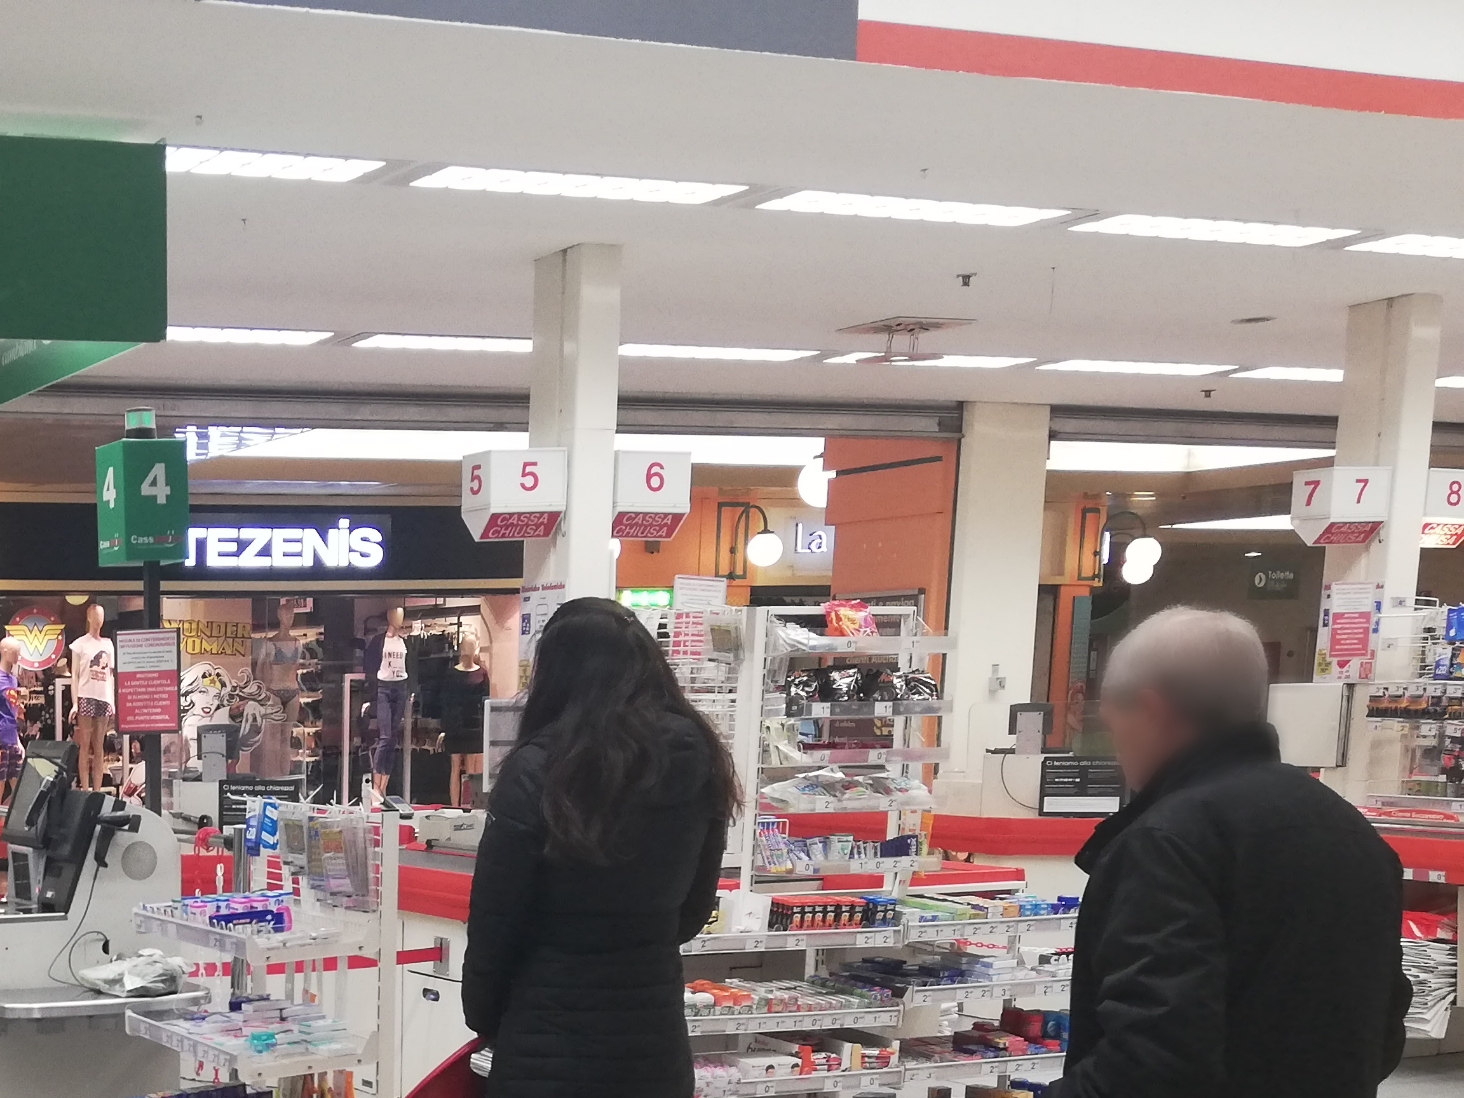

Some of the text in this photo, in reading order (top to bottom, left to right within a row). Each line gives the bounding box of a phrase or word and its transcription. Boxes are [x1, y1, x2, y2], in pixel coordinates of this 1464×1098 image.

[102, 466, 117, 510] 4
[140, 462, 171, 505] 4
[469, 464, 482, 496] 5
[520, 461, 539, 492] 5
[645, 461, 665, 493] 6
[1304, 479, 1321, 507] 7
[1354, 478, 1370, 504] 7
[1446, 480, 1462, 507] 8
[488, 525, 545, 538] CHIUSA
[496, 513, 549, 526] CASSA
[612, 525, 667, 537] CHIUSA
[622, 513, 672, 525] CASSA
[1331, 523, 1373, 533] CASSA
[1320, 533, 1366, 544] CHIUSA
[161, 619, 252, 639] WONDER
